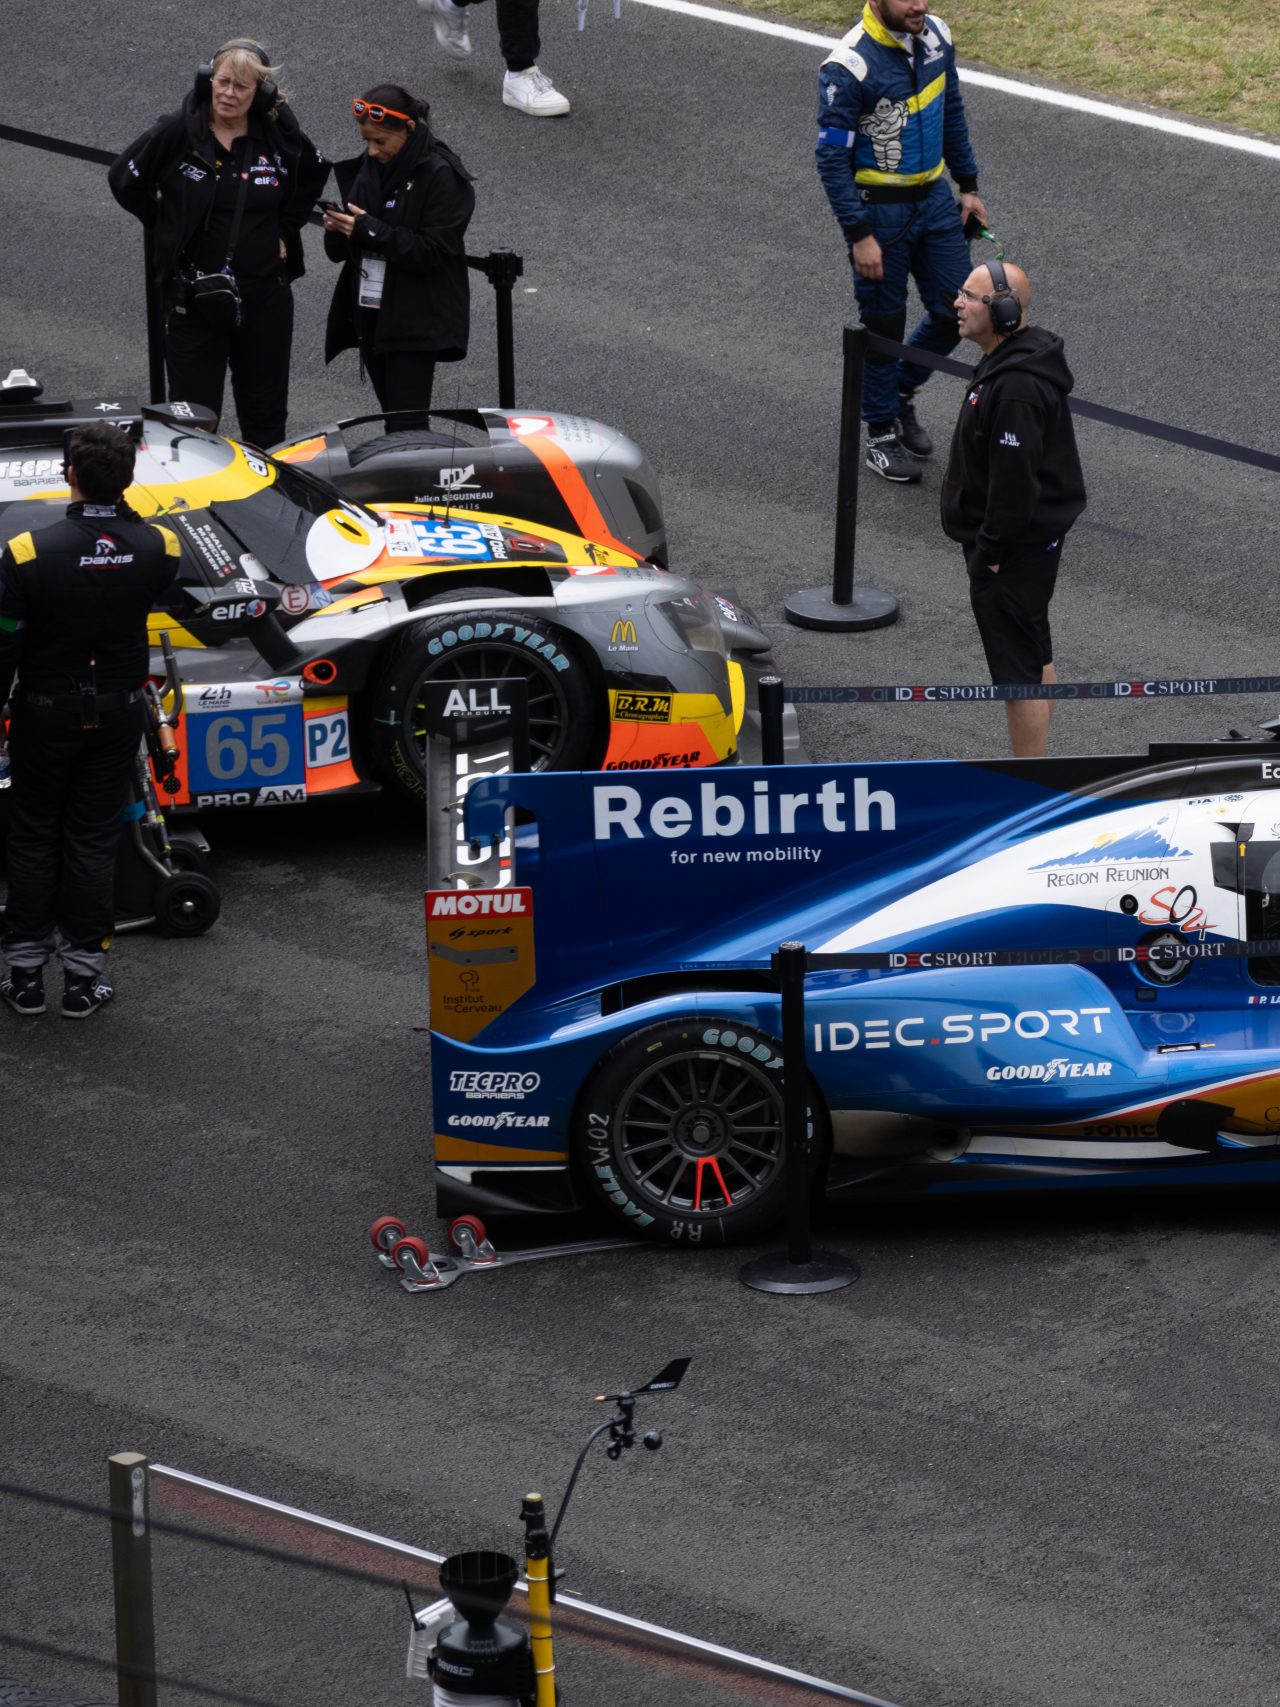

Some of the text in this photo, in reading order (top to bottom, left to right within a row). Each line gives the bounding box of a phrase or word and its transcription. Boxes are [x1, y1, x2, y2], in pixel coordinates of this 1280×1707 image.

[0, 459, 65, 479] TECPR
[415, 524, 488, 555] 65
[211, 602, 247, 620] elf
[895, 686, 999, 701] IDEC SPORT
[1114, 680, 1217, 696] IDEC SPORT
[442, 687, 511, 717] ALL
[205, 713, 290, 780] 65
[308, 718, 348, 762] P2
[197, 788, 305, 809] PRO AM
[592, 777, 897, 841] Rebirth
[670, 846, 822, 864] for new mobility
[1047, 867, 1170, 888] REGION REUNION
[431, 893, 527, 916] MOTUL
[889, 951, 997, 967] IDEC SPORT
[1117, 943, 1225, 961] IDEC SPORT
[443, 994, 485, 1004] Institut
[454, 1004, 503, 1013] Cerveau
[450, 1071, 541, 1093] TECPRO
